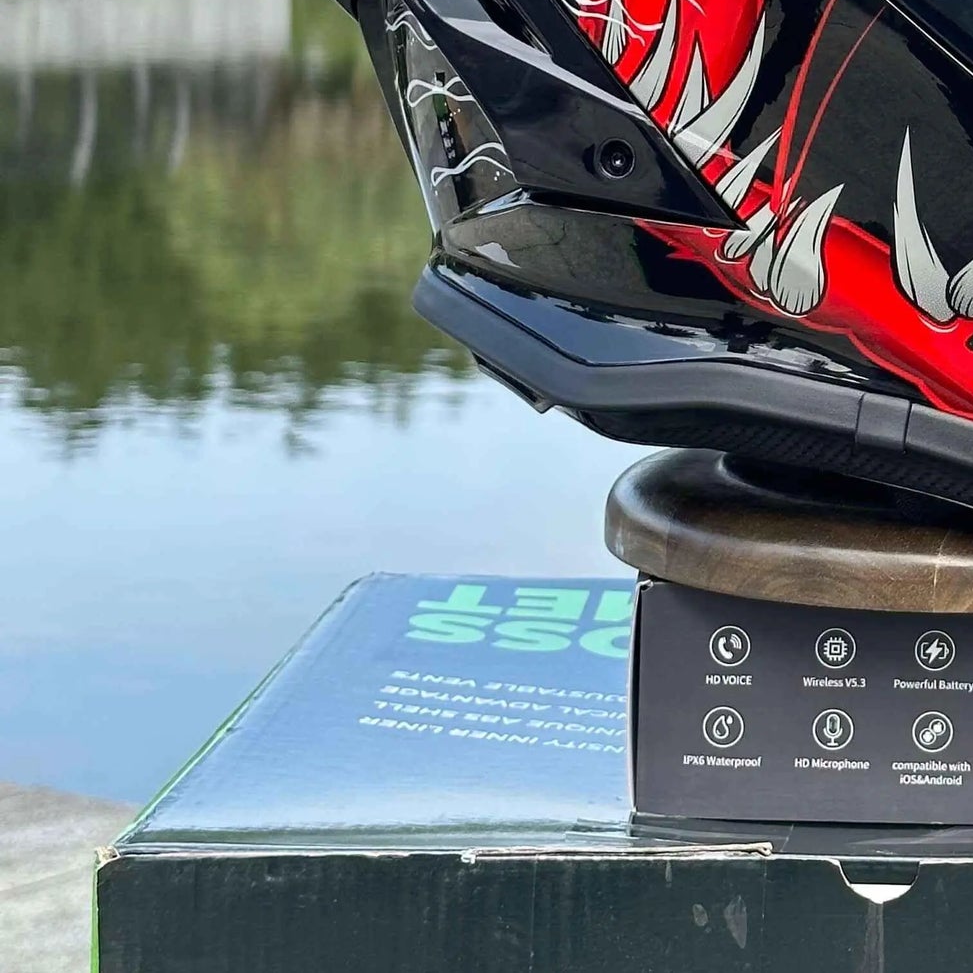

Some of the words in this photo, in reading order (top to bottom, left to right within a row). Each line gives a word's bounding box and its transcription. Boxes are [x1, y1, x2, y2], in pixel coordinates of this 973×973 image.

[404, 613, 632, 658] OSS
[389, 670, 476, 688] VENTS
[705, 675, 721, 686] HD
[722, 675, 752, 686] VOICE
[803, 677, 844, 688] Wireless
[845, 678, 866, 688] V5.3
[893, 679, 937, 690] Powerful
[380, 685, 552, 711] ADVANTAGE
[374, 700, 459, 718] SHELL
[358, 716, 444, 734] LINER
[464, 712, 522, 725] ABS
[449, 728, 538, 745] INNER
[544, 738, 627, 754] NSITY
[683, 755, 705, 765] IPX6
[706, 756, 762, 768] Waterproof
[795, 758, 811, 768] HD
[812, 758, 870, 770] Microphone
[892, 761, 947, 772] compatible
[949, 761, 971, 772] with
[900, 774, 963, 786] iOS&Android
